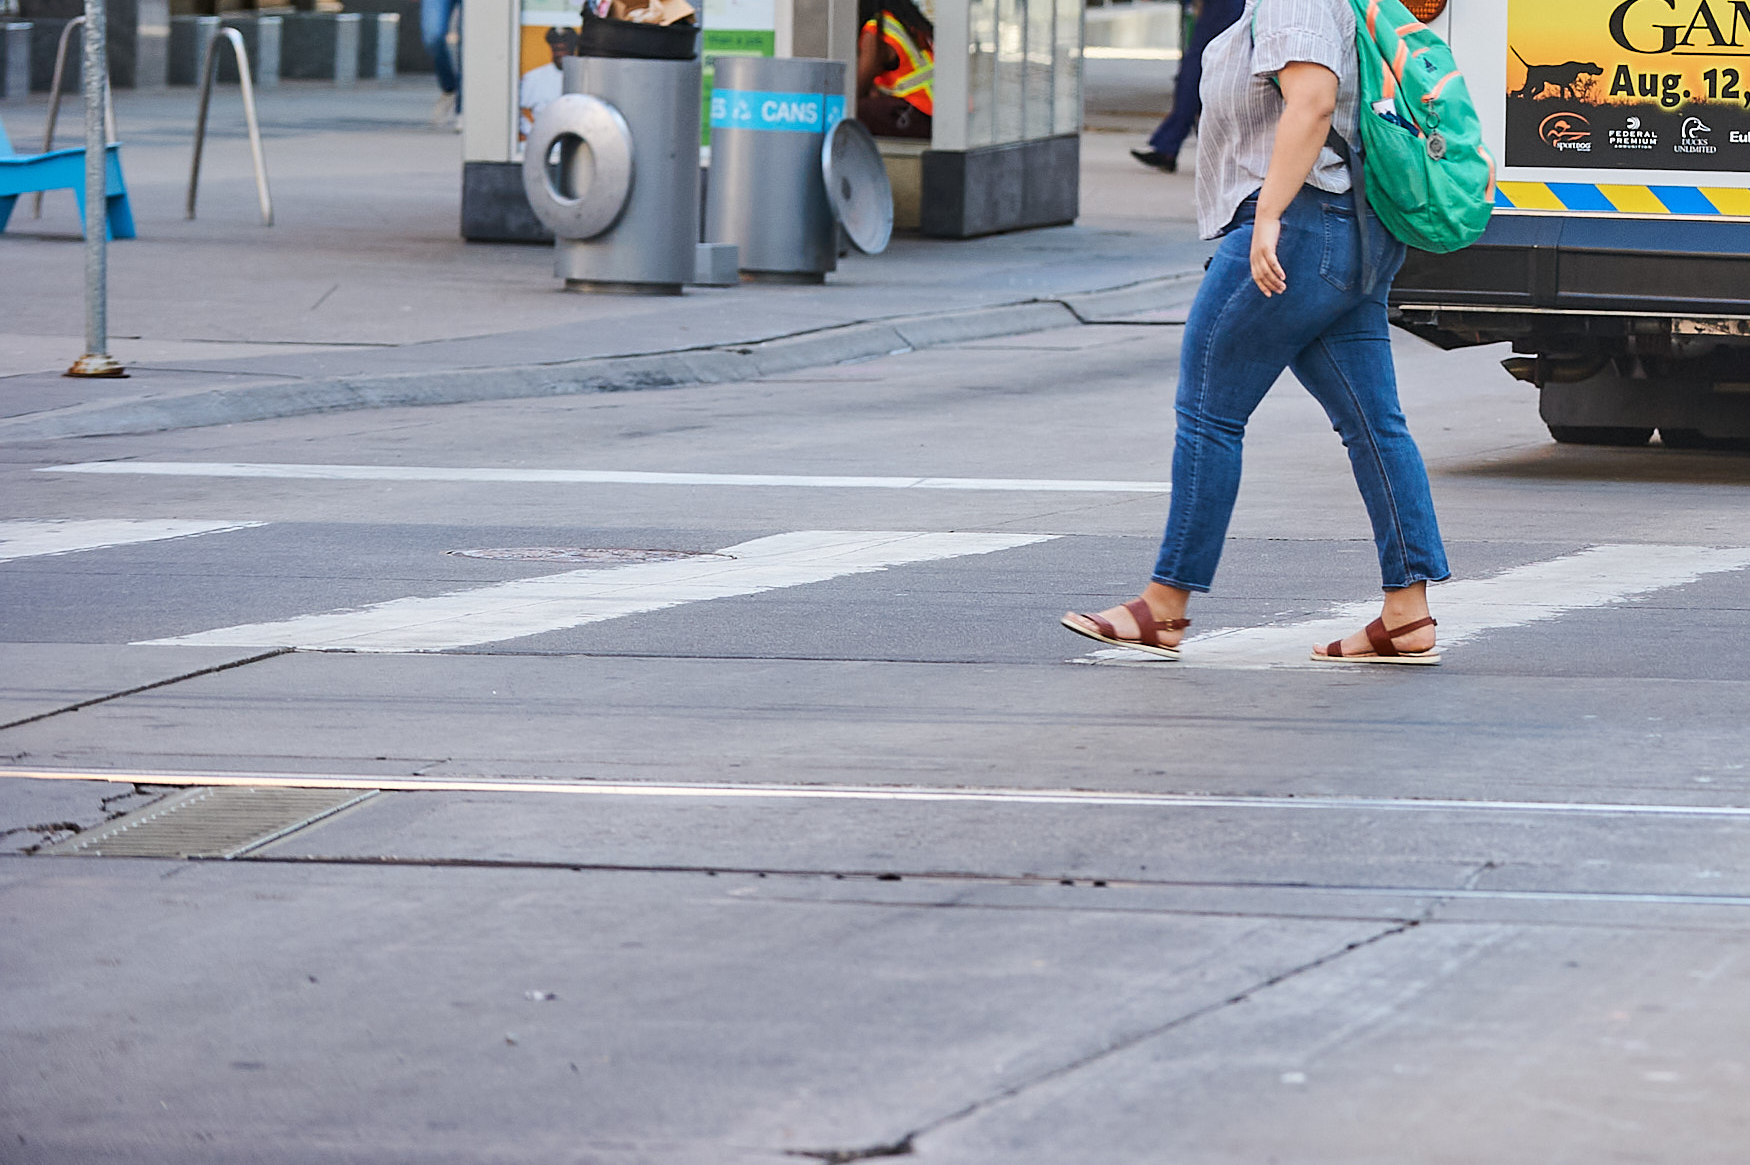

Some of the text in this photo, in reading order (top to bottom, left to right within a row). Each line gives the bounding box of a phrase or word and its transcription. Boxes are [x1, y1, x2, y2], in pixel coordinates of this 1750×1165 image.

[1609, 64, 1691, 107] Aug.
[761, 100, 818, 124] CANS
[1609, 130, 1658, 138] FEDERAL
[1609, 137, 1658, 145] PREMIUM
[1681, 138, 1709, 146] DUCKS
[1673, 145, 1717, 154] UNLIMITED
